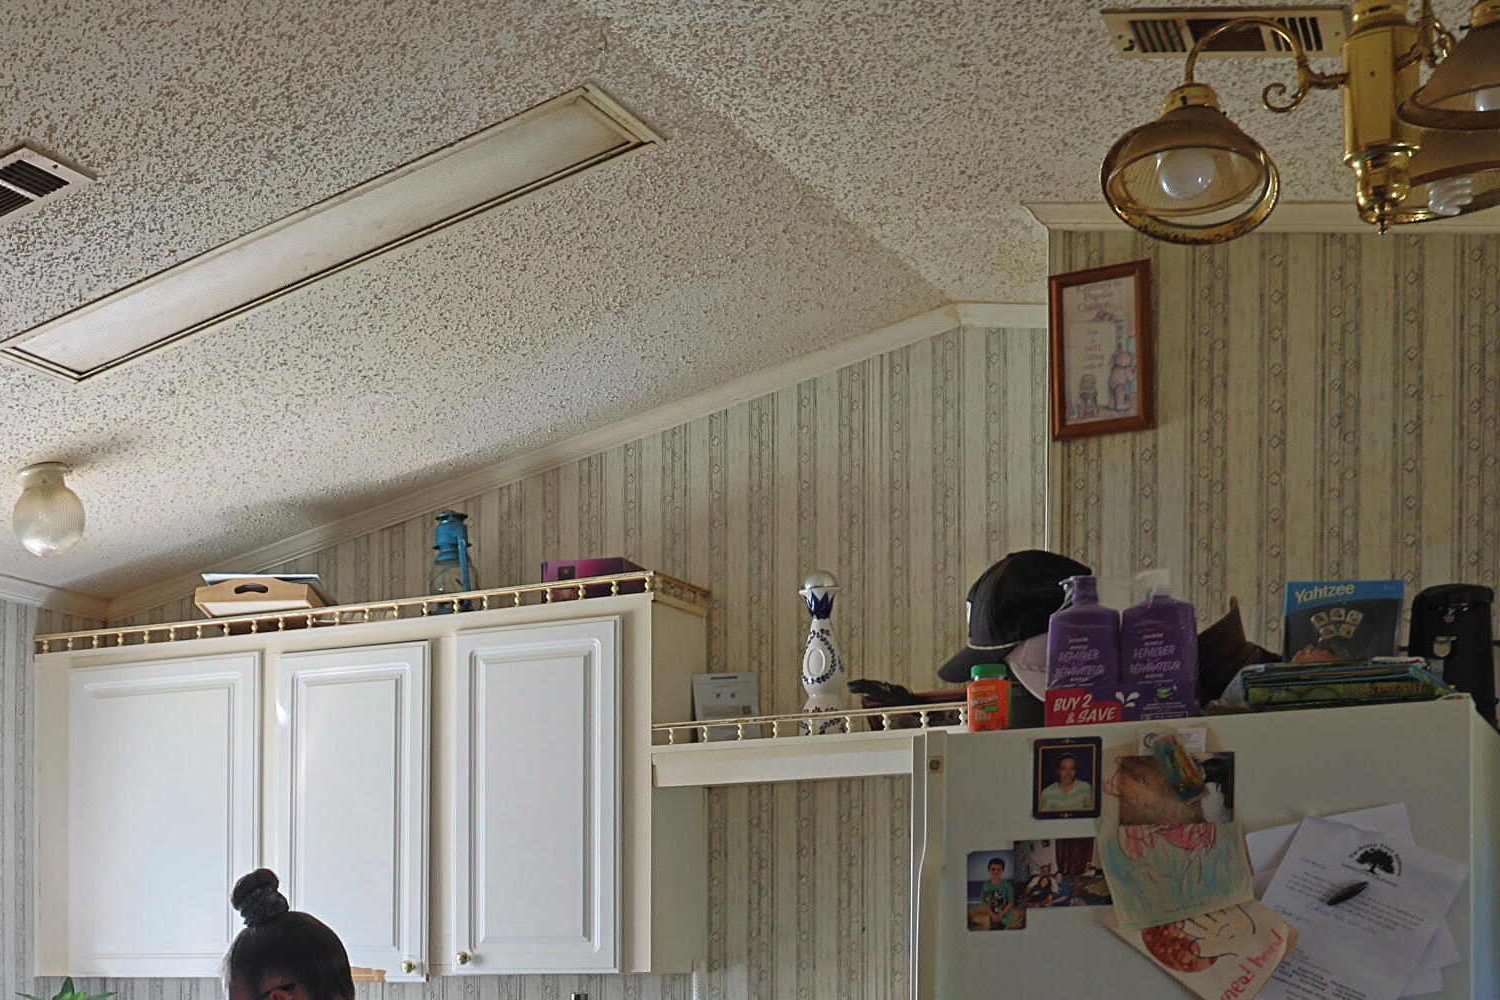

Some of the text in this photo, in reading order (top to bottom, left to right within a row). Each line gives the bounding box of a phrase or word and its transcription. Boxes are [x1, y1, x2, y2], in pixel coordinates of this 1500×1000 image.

[1294, 584, 1356, 604] Yahtzee
[1053, 693, 1093, 712] BUY 2
[1066, 705, 1117, 724] & SAVE
